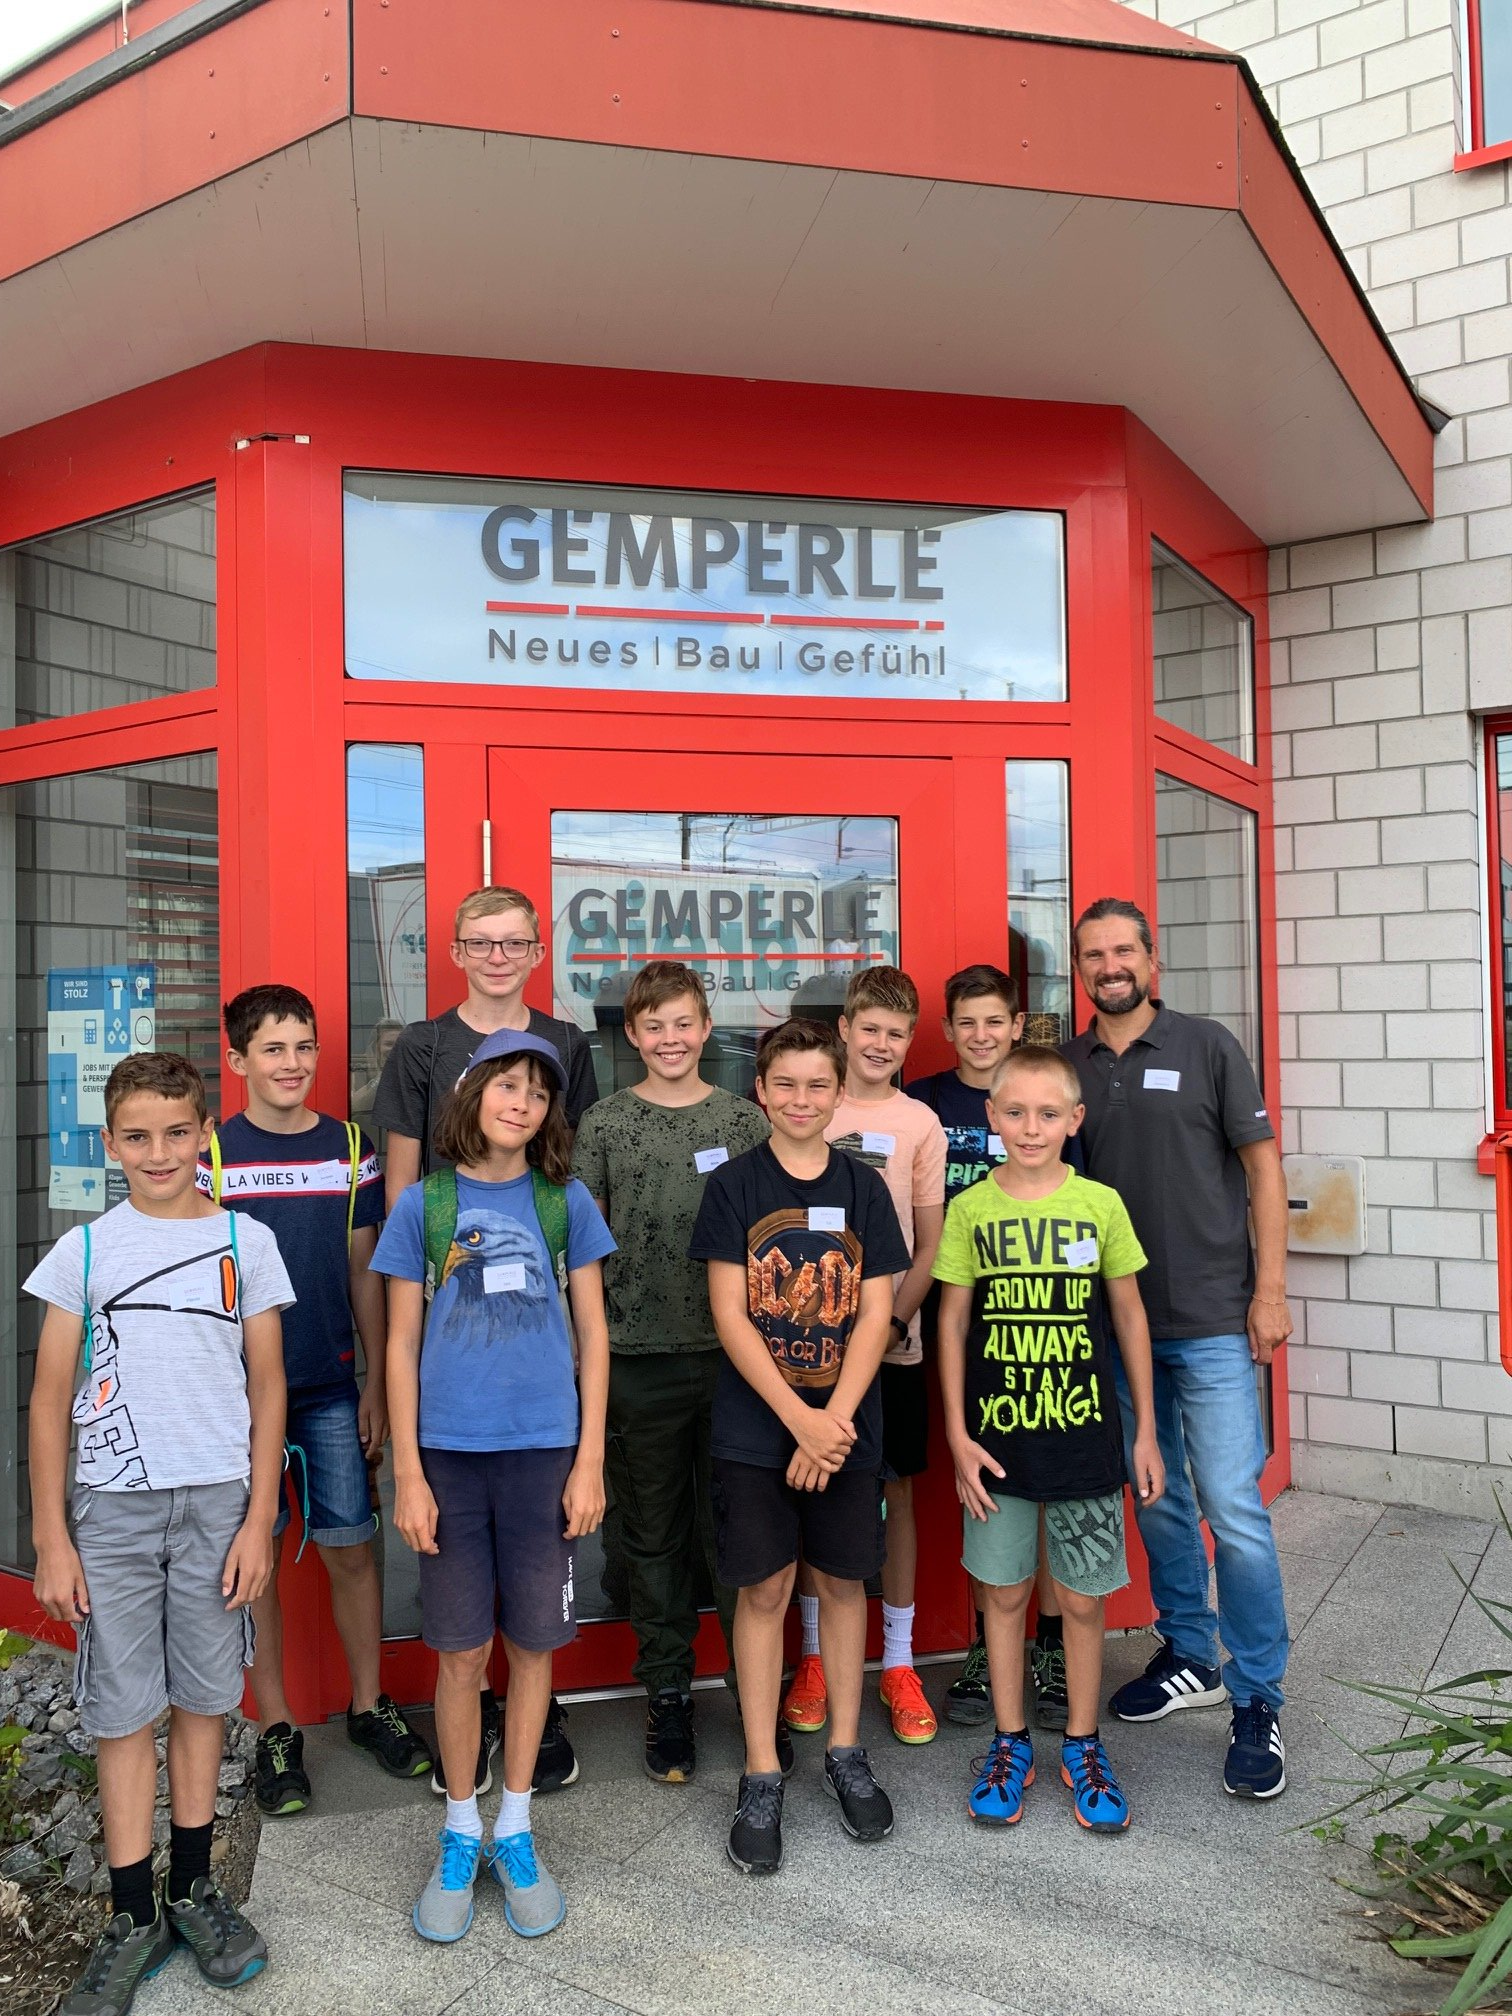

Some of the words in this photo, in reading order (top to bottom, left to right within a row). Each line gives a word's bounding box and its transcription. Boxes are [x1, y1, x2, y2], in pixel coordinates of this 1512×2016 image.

[481, 504, 944, 600] GEMPERLE
[489, 628, 638, 666] Neues
[677, 637, 761, 670] Bau
[799, 641, 946, 676] Gefühl
[569, 888, 883, 939] GEMPERLE
[63, 980, 75, 988] WIR
[75, 980, 88, 988] SIND
[63, 988, 88, 999] STOLZ
[701, 971, 756, 992] Bau
[82, 1064, 98, 1072] JOBS
[228, 1175, 248, 1188] LA
[252, 1172, 295, 1186] VIBES
[1065, 1278, 1092, 1309] UP
[984, 1324, 1093, 1363] ALWAYS
[1004, 1366, 1072, 1392] STAY
[978, 1373, 1102, 1435] YOUNG!
